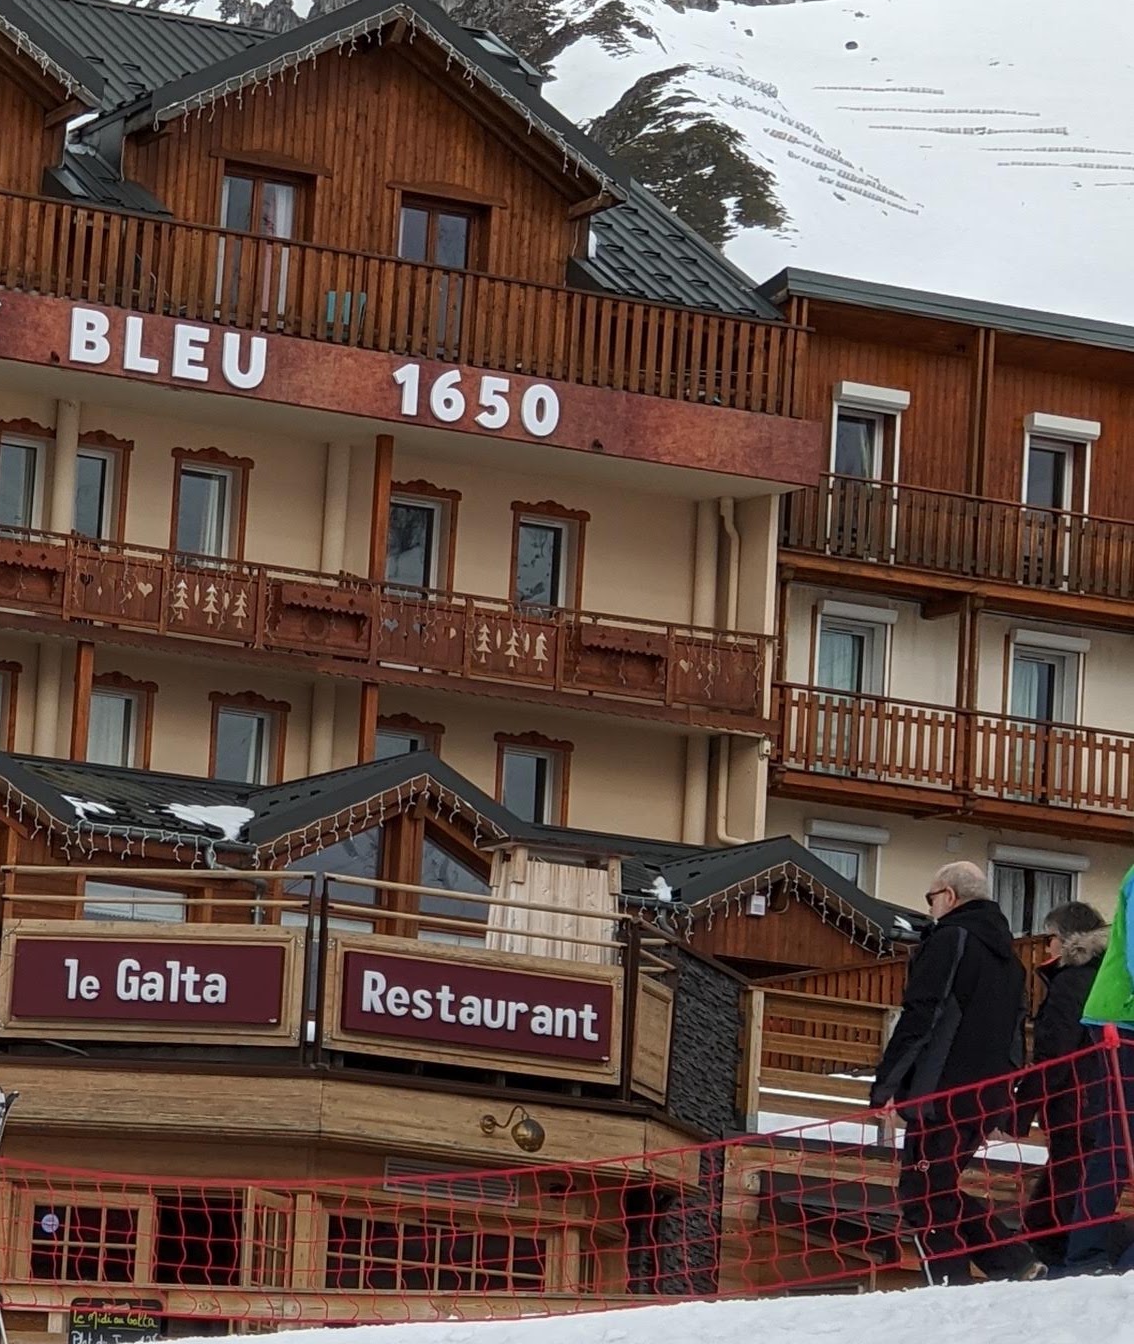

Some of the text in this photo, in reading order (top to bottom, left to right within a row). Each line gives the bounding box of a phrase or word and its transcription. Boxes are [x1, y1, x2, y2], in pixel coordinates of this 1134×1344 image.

[69, 306, 267, 390] BLEU
[392, 362, 561, 438] 1650
[64, 958, 227, 1005] le Galta
[361, 970, 599, 1043] Restaurant
